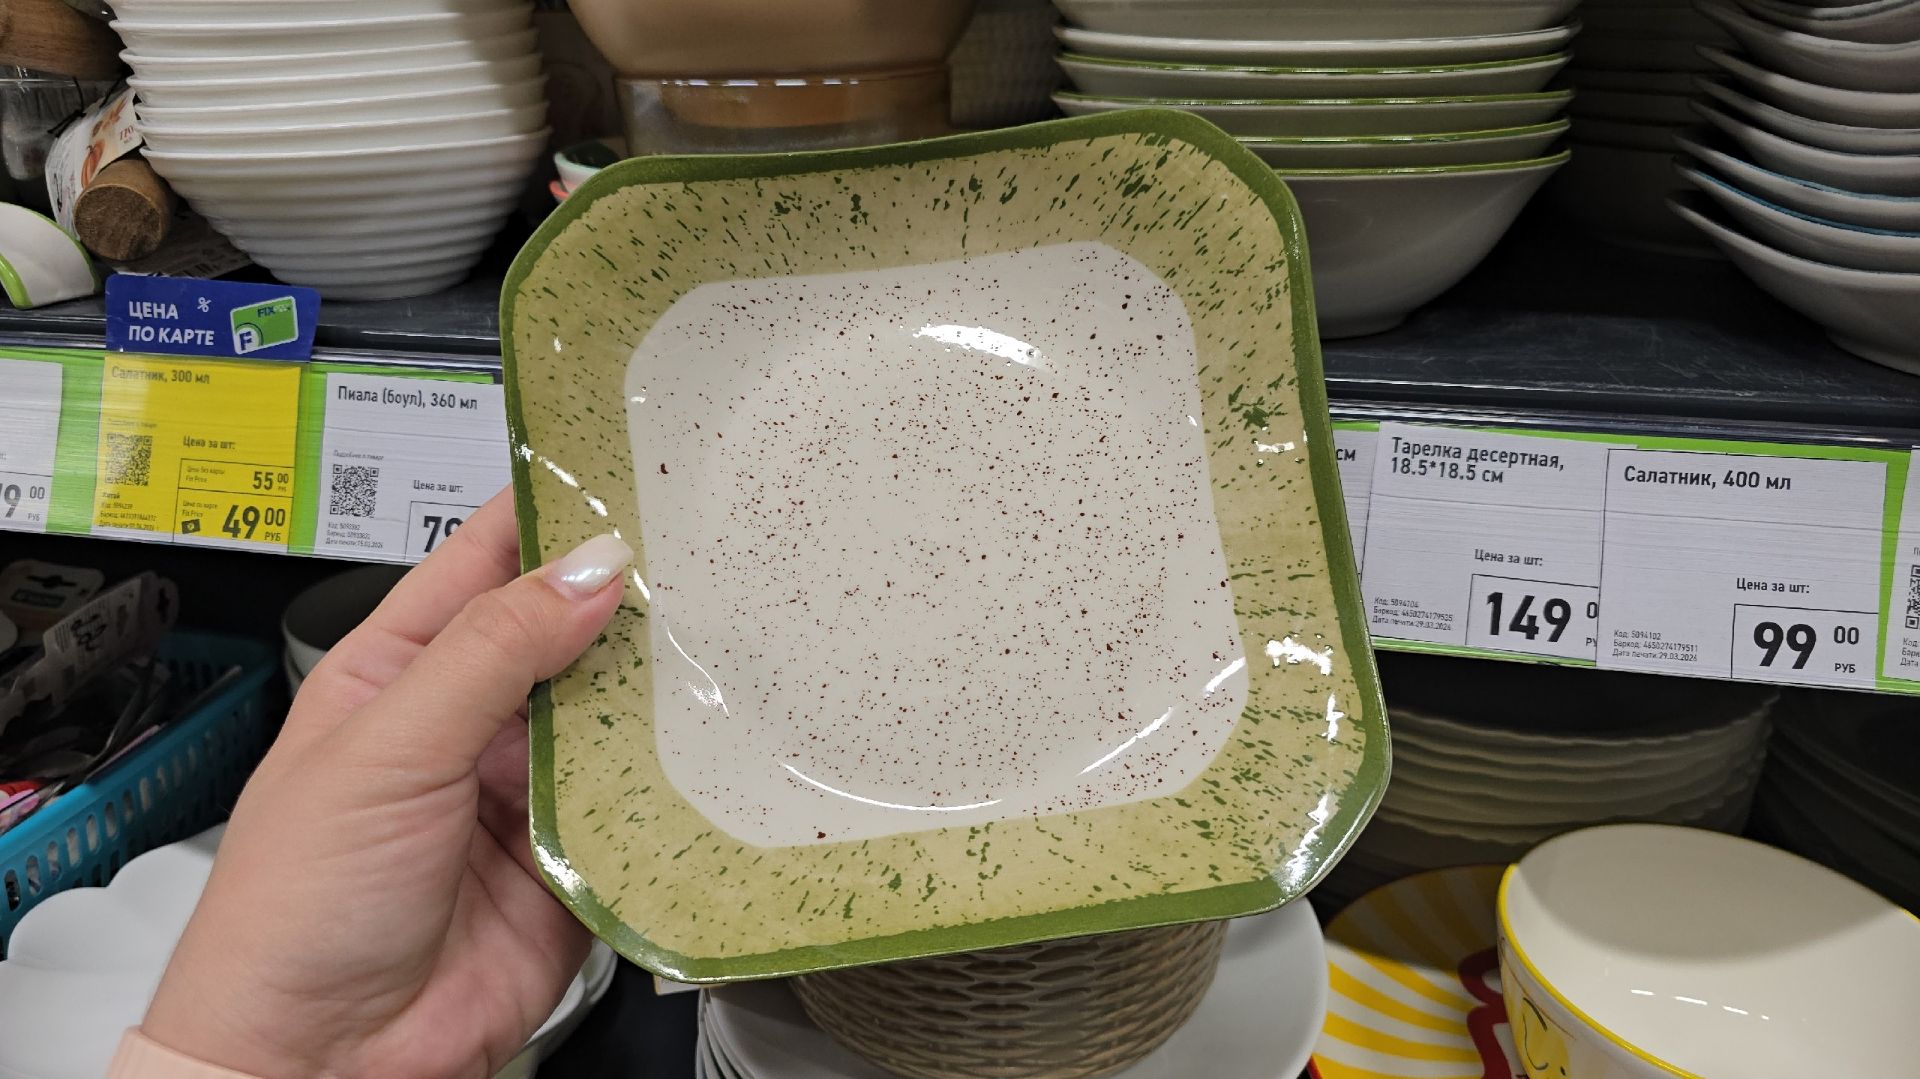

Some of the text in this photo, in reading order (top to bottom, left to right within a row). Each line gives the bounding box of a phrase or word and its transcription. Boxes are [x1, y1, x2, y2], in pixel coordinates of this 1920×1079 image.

[129, 301, 178, 320] ЦЕНА
[129, 325, 214, 346] ПО КАРТЕ
[111, 366, 210, 385] Салатник, 300 мл
[338, 386, 478, 410] Пиала (боул), 360 мл
[183, 435, 236, 450] Цена за шт:
[1336, 448, 1356, 461] см
[1391, 437, 1565, 472] Тарелка десертная,
[252, 471, 289, 490] 55 00
[1482, 468, 1503, 484] см
[1624, 465, 1791, 490] Салатник, 400 мл
[413, 480, 464, 493] Цена за шт:
[0, 483, 46, 518] 9 00
[28, 513, 40, 522] РУБ
[222, 504, 286, 539] 49 00
[264, 531, 281, 541] РУБ
[1474, 549, 1543, 566] Цена за шт:
[1736, 577, 1810, 594] Цена за шт:
[1374, 597, 1389, 606] Код:
[1373, 606, 1400, 616] Баркод:
[1487, 591, 1571, 643] 149
[1372, 615, 1389, 624] Дата
[1614, 629, 1661, 640] Код: 5094102
[1612, 648, 1630, 658] Дата
[1613, 638, 1698, 652] Баркод: 4650274179511
[1753, 621, 1860, 670] 99 00
[1834, 663, 1856, 674] РУБ
